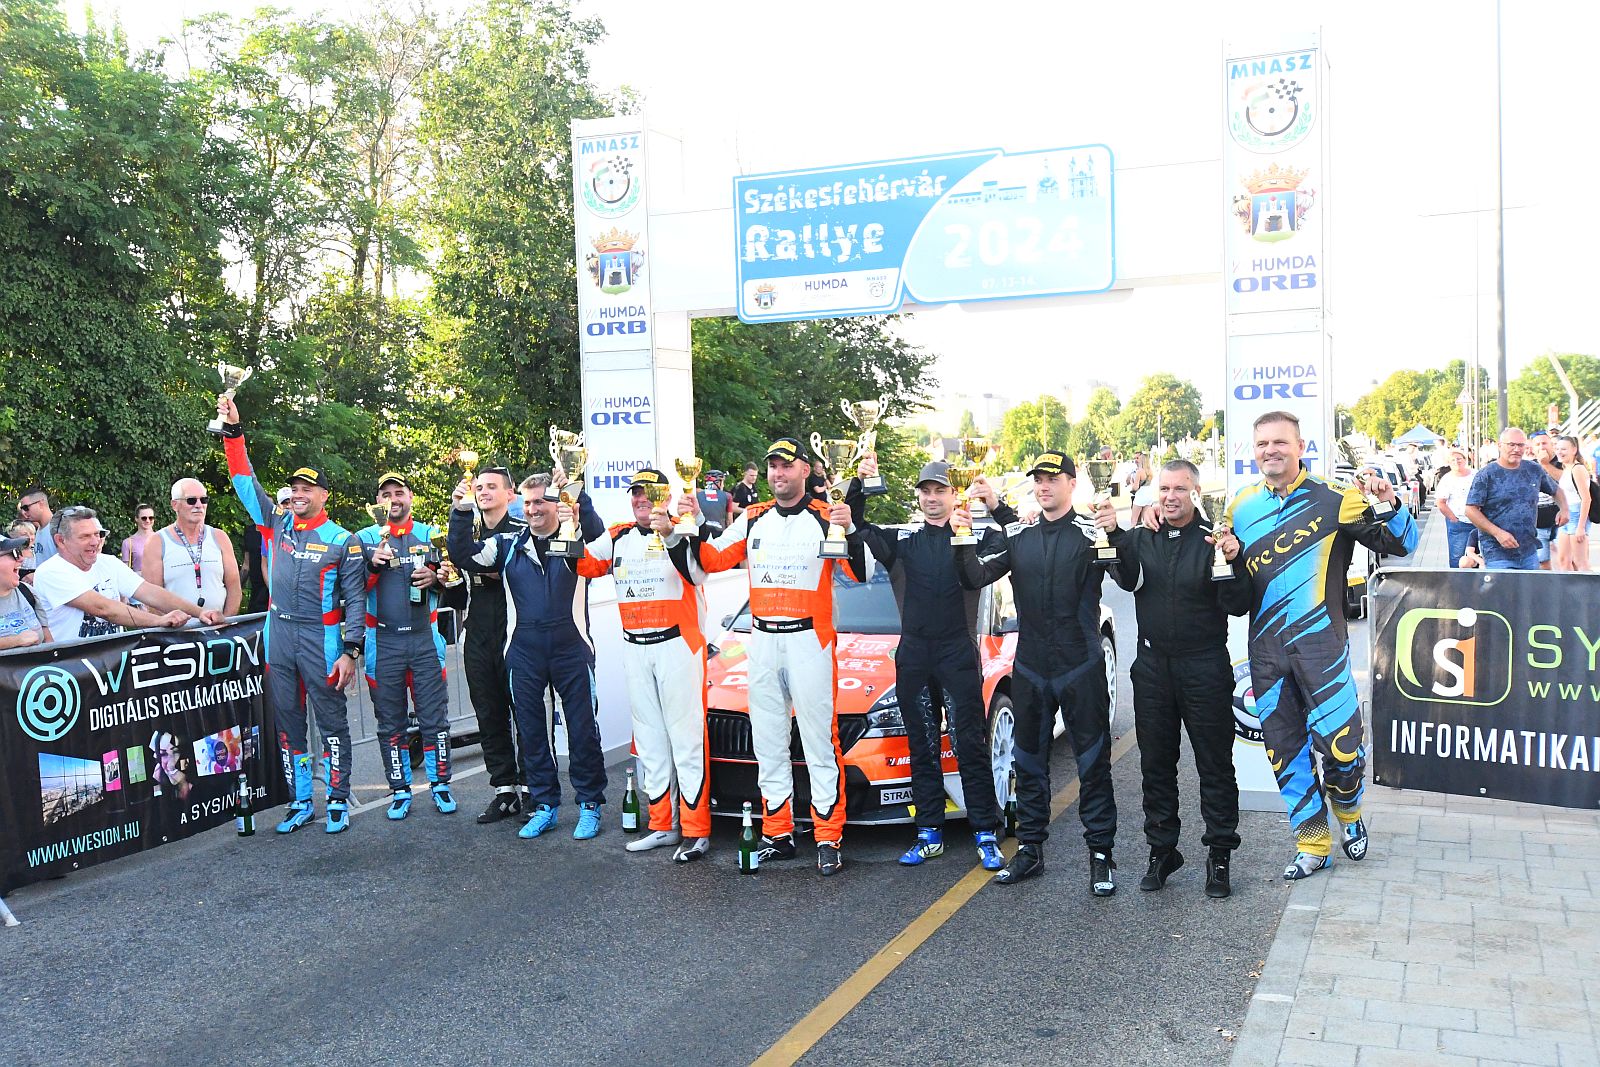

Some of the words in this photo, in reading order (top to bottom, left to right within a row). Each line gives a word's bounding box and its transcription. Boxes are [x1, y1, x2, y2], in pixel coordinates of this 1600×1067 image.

[1231, 54, 1312, 80] MNASZ
[581, 136, 639, 155] MNASZ
[744, 169, 947, 214] Székesfehérvár
[741, 223, 885, 263] Rallye
[944, 215, 1084, 269] 2024
[1252, 254, 1316, 272] HUMDA
[804, 278, 848, 291] HUMDA
[1232, 272, 1317, 293] ORB
[600, 305, 646, 319] HUMDA
[587, 320, 647, 336] ORB
[1253, 364, 1317, 380] HUMDA
[1233, 382, 1318, 400] ORC
[604, 396, 651, 408] HUMDA
[591, 411, 651, 426] ORC
[607, 460, 652, 472] HUMDA
[594, 475, 634, 488] HIS
[1274, 516, 1323, 553] Car
[81, 631, 262, 696] WESION
[162, 674, 264, 714] REKLÁMTÁBLÁK
[89, 698, 160, 731] DIGITÁLIS
[390, 745, 402, 781] racing
[180, 812, 188, 825] A
[191, 785, 267, 820] SYSINO-TÓL
[27, 820, 141, 868] WWW.WESION.HU
